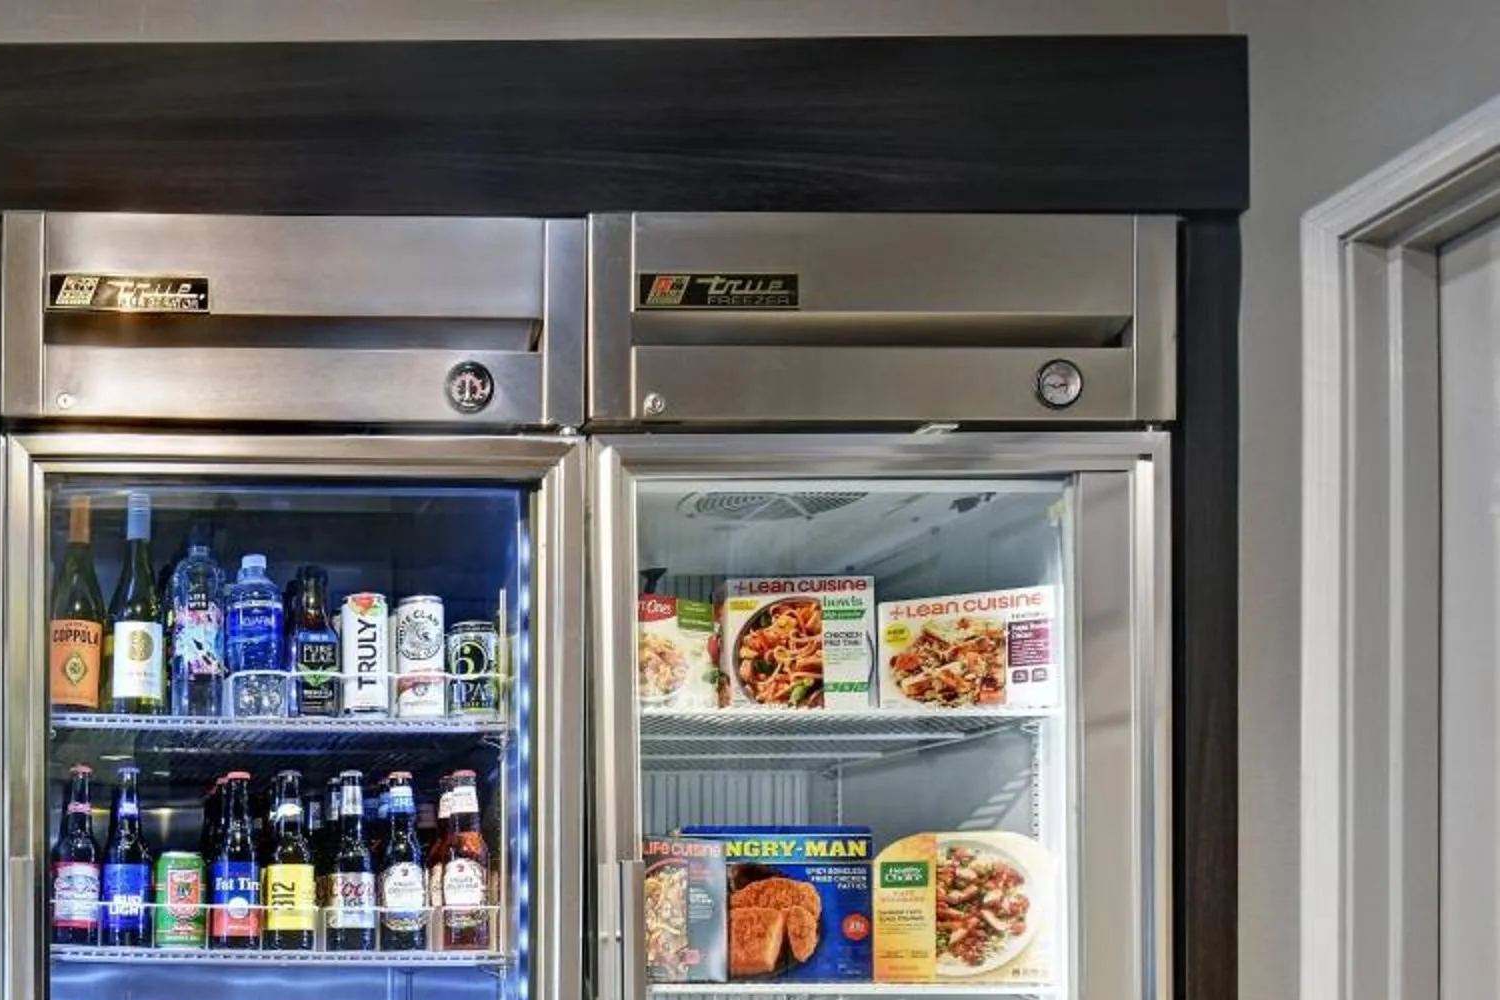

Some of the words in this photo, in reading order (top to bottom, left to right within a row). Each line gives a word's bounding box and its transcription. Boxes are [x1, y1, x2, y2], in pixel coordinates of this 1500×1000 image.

[747, 579, 796, 593] Lean
[906, 601, 960, 618] Lean
[357, 618, 378, 691] TRULY
